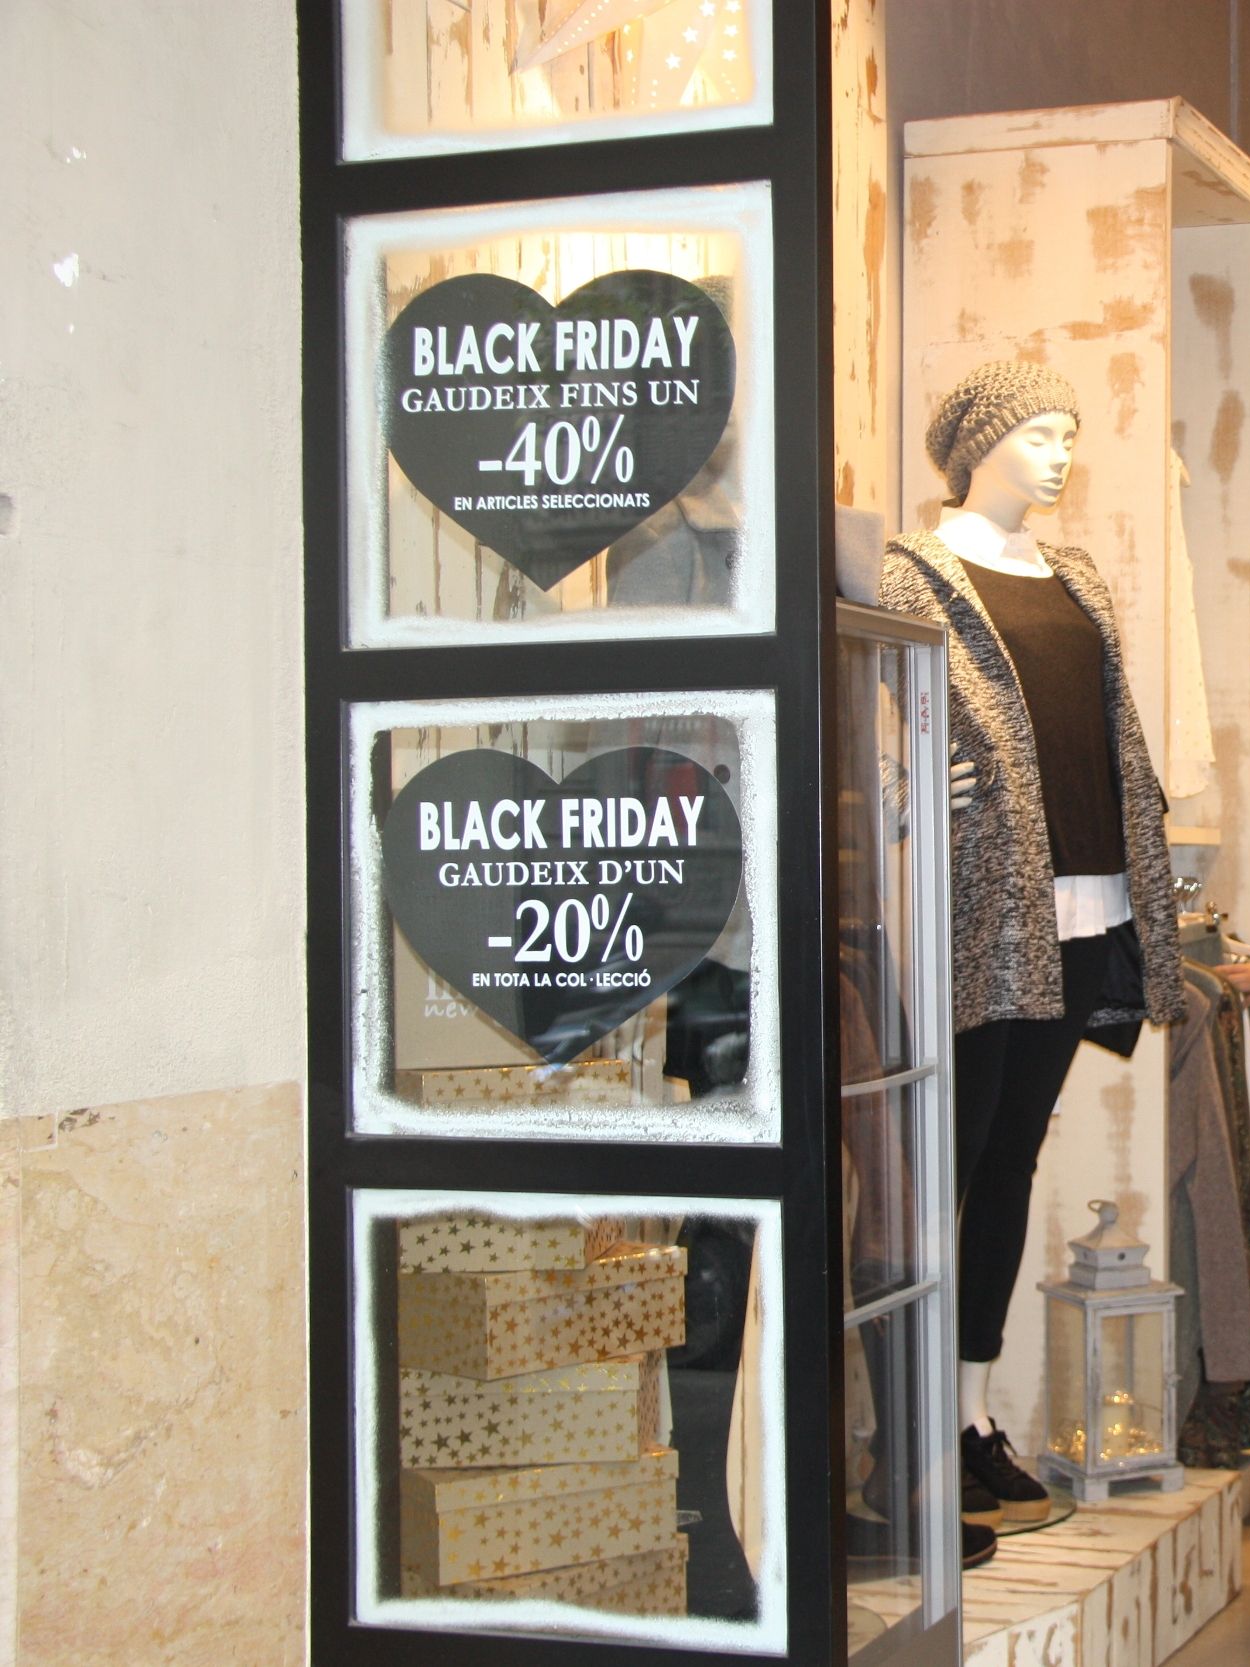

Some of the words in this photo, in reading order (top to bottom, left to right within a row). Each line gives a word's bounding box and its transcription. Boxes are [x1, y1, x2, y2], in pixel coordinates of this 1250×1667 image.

[413, 321, 542, 377] BLACK
[555, 315, 700, 372] FRIDAY
[401, 384, 551, 413] GAUDEIX
[560, 380, 638, 408] FINS
[647, 379, 700, 406] UN
[478, 413, 635, 487] -40%
[454, 496, 473, 511] EN
[475, 494, 539, 511] ARTICLES
[541, 492, 651, 510] SELECCIONATS
[419, 798, 548, 851] BLACK
[561, 795, 705, 849] FRIDAY
[438, 860, 590, 887] GAUDEIX
[487, 892, 644, 963] -20%
[472, 972, 491, 988] EN
[493, 972, 531, 988] TOTA
[534, 972, 552, 988] LA
